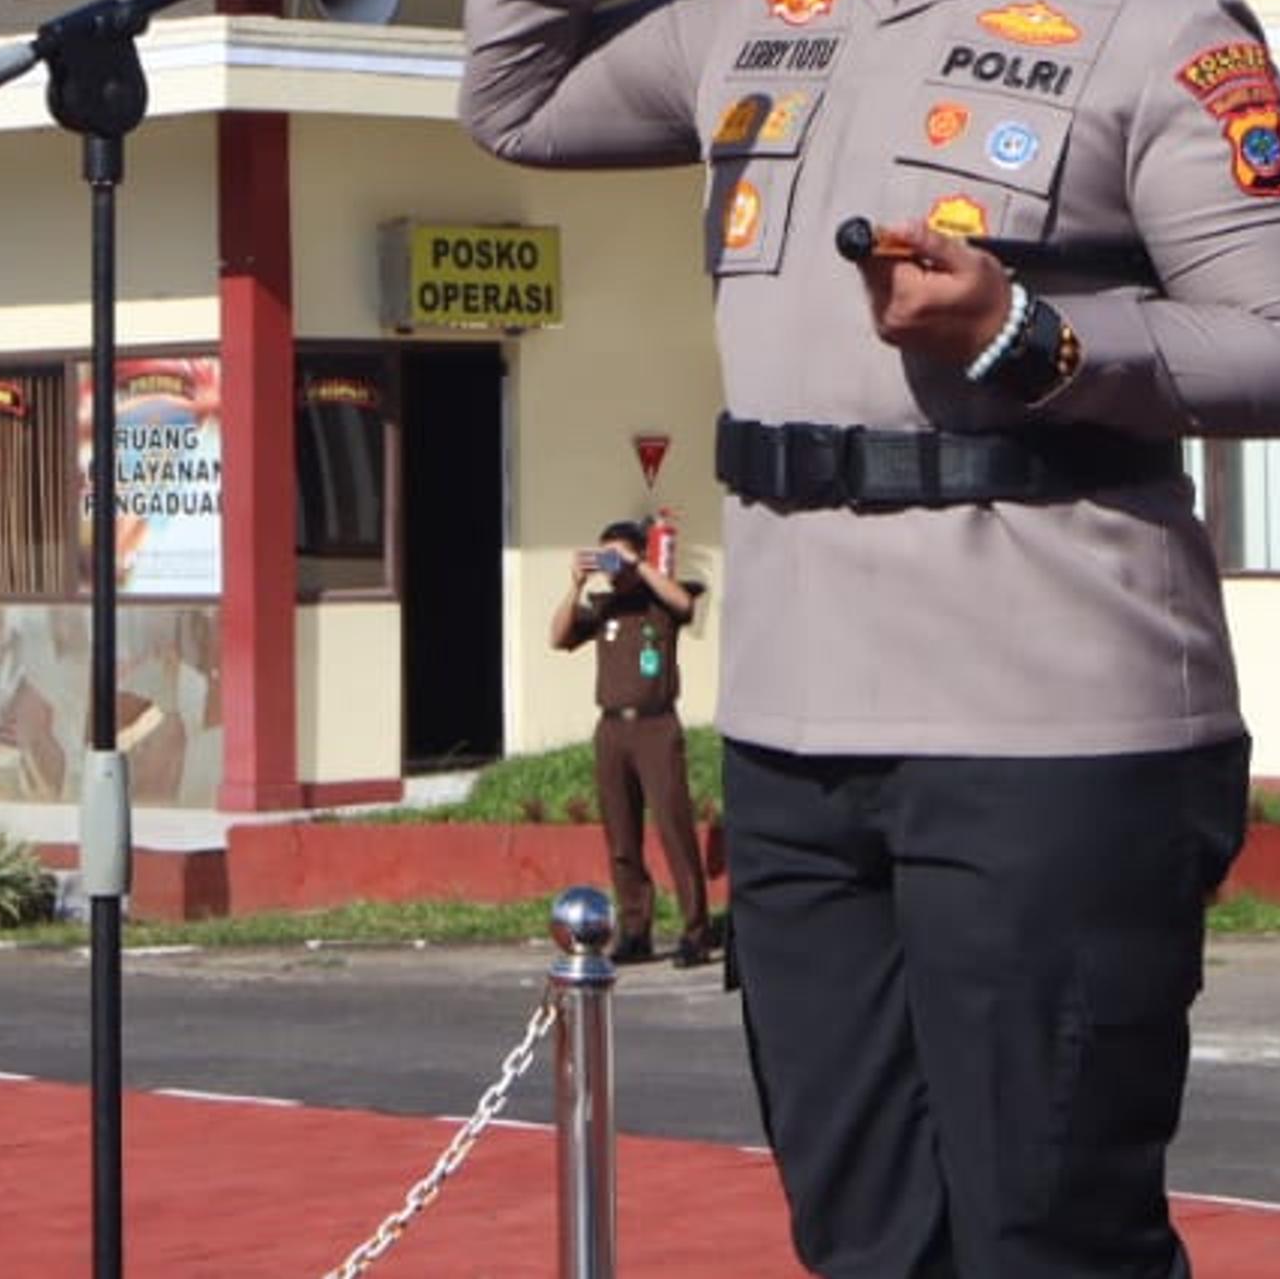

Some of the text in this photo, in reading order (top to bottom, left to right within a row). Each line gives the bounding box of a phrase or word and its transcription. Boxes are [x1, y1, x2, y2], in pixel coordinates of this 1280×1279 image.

[941, 45, 1073, 95] POLRI
[432, 238, 539, 269] POSKO
[419, 282, 553, 314] OPERASI
[113, 426, 200, 450] RUANG
[89, 459, 221, 483] LAYANAN
[85, 492, 222, 516] PNGADUA
